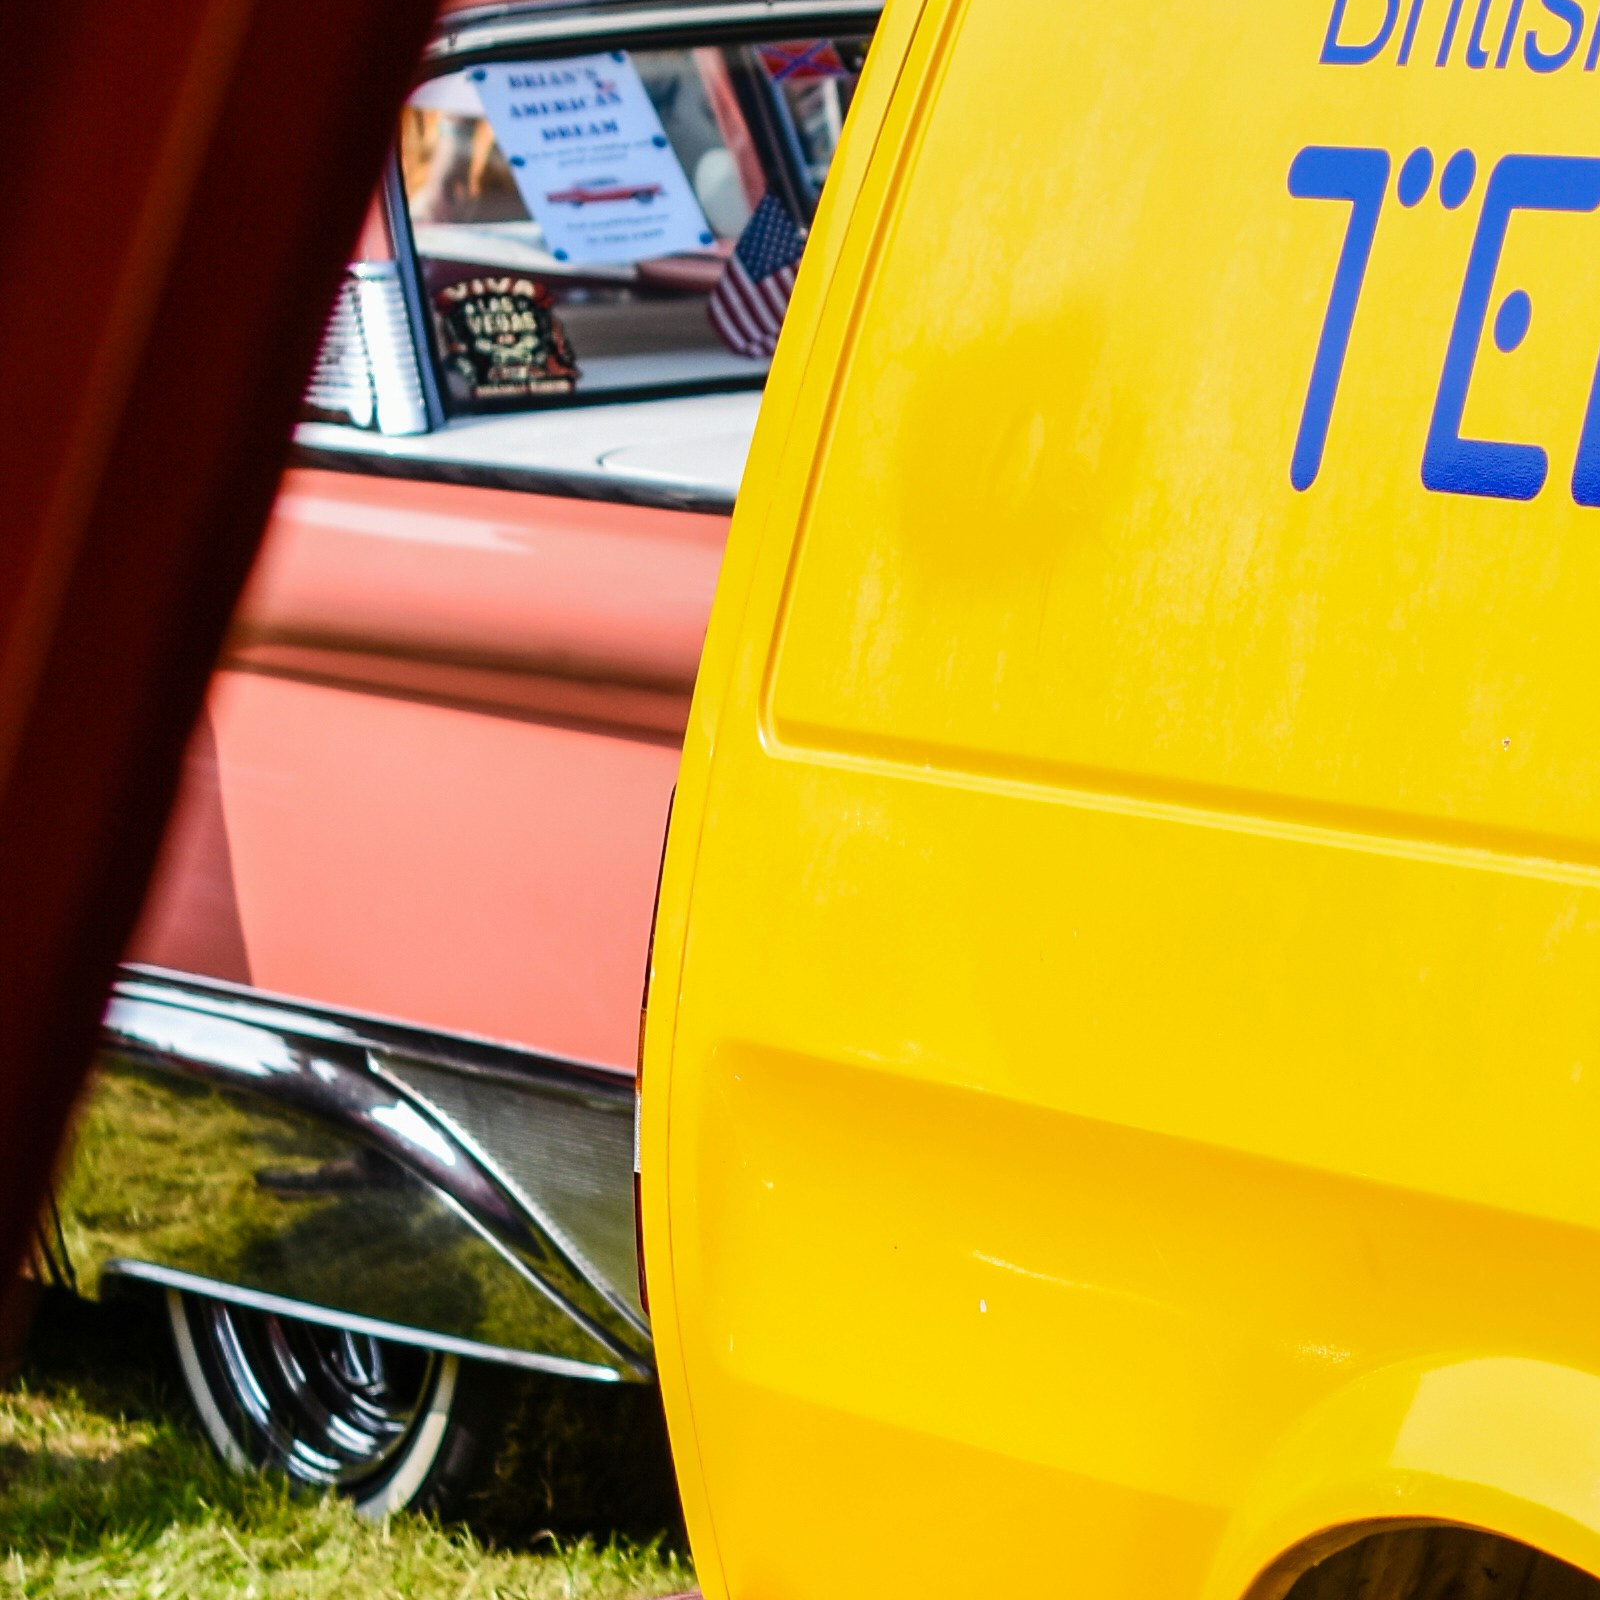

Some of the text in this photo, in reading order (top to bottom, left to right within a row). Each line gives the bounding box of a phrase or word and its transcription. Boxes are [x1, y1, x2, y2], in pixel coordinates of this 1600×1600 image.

[507, 68, 599, 89] BRIAN'S
[510, 92, 622, 119] AMERICAN
[542, 118, 619, 141] DREAM
[442, 276, 537, 300] VIVA
[466, 311, 537, 335] VEGAS
